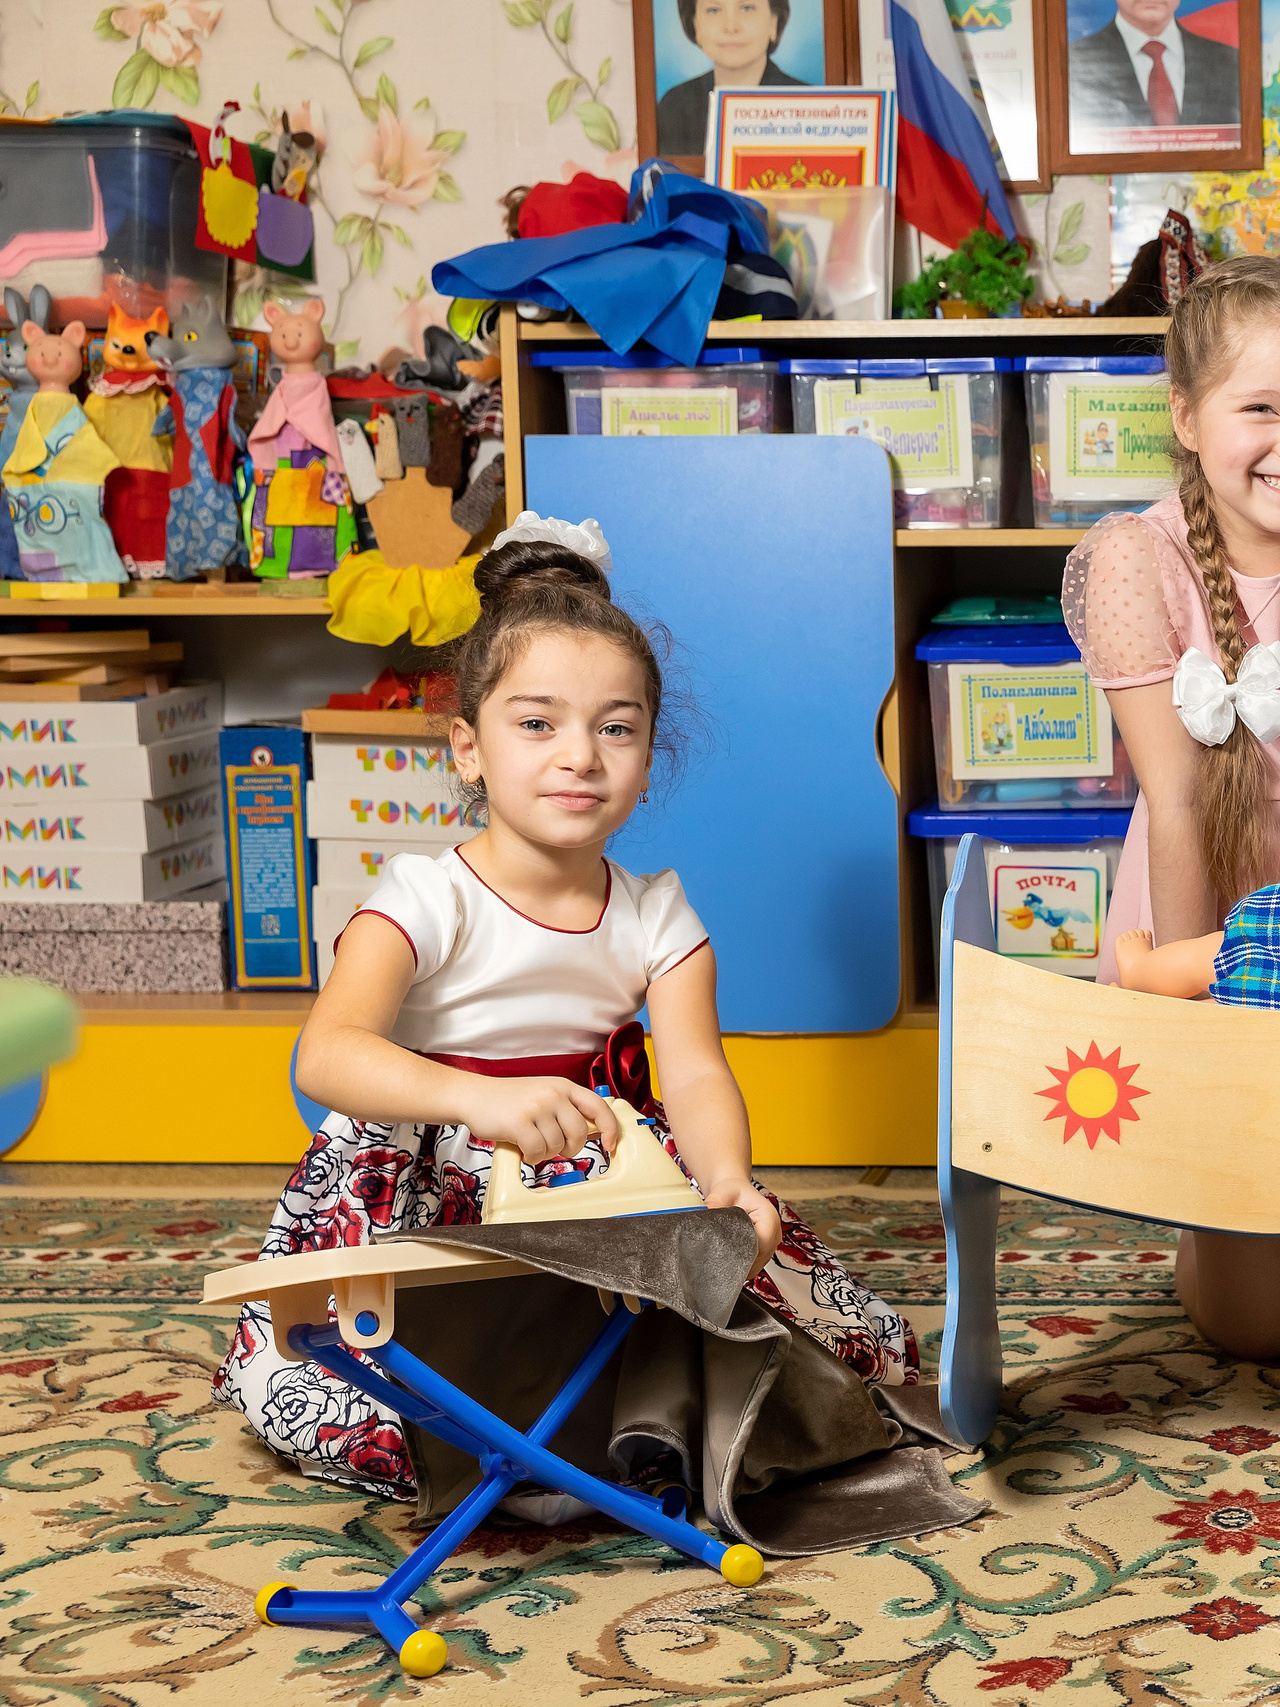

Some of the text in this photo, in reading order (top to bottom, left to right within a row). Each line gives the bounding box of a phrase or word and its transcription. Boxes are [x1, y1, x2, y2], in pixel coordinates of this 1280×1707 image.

[734, 105, 868, 119] ГОСУДАРСТВЕННЫЙ ГЕРБ
[733, 122, 868, 138] РОССИЙСКОЙ ФЕДЕРАЦИИ
[981, 685, 1078, 699] Поликлиника
[0, 763, 88, 789] МИК
[0, 817, 86, 842] МИК
[1016, 875, 1076, 892] ПОЧТА
